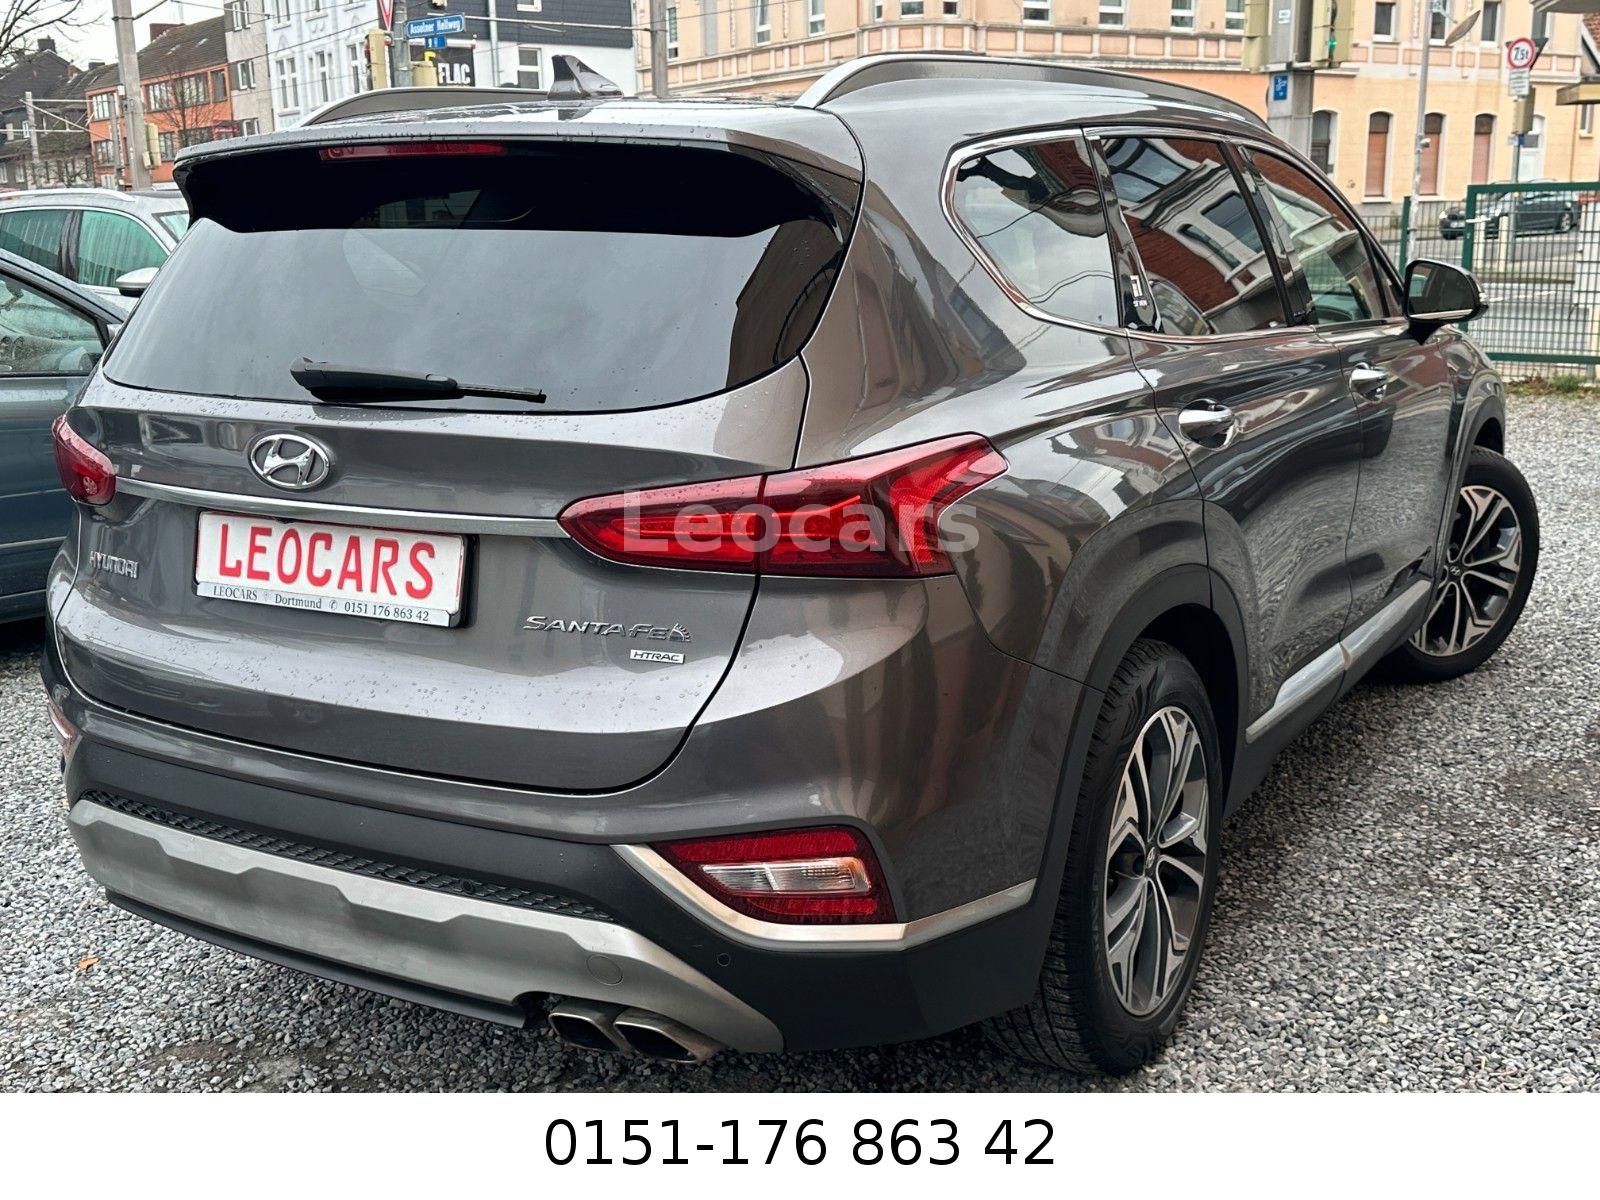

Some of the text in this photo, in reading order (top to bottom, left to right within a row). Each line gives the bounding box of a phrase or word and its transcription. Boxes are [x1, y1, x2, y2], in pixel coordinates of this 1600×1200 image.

[410, 19, 460, 34] Asselner Hellweg
[89, 550, 139, 579] HYUNDAI
[219, 523, 435, 600] LEOCARS
[213, 585, 430, 622] LEOCARS Dortmund 0151 176 863 42
[522, 615, 627, 638] SANTA
[633, 651, 680, 661] HTRAC
